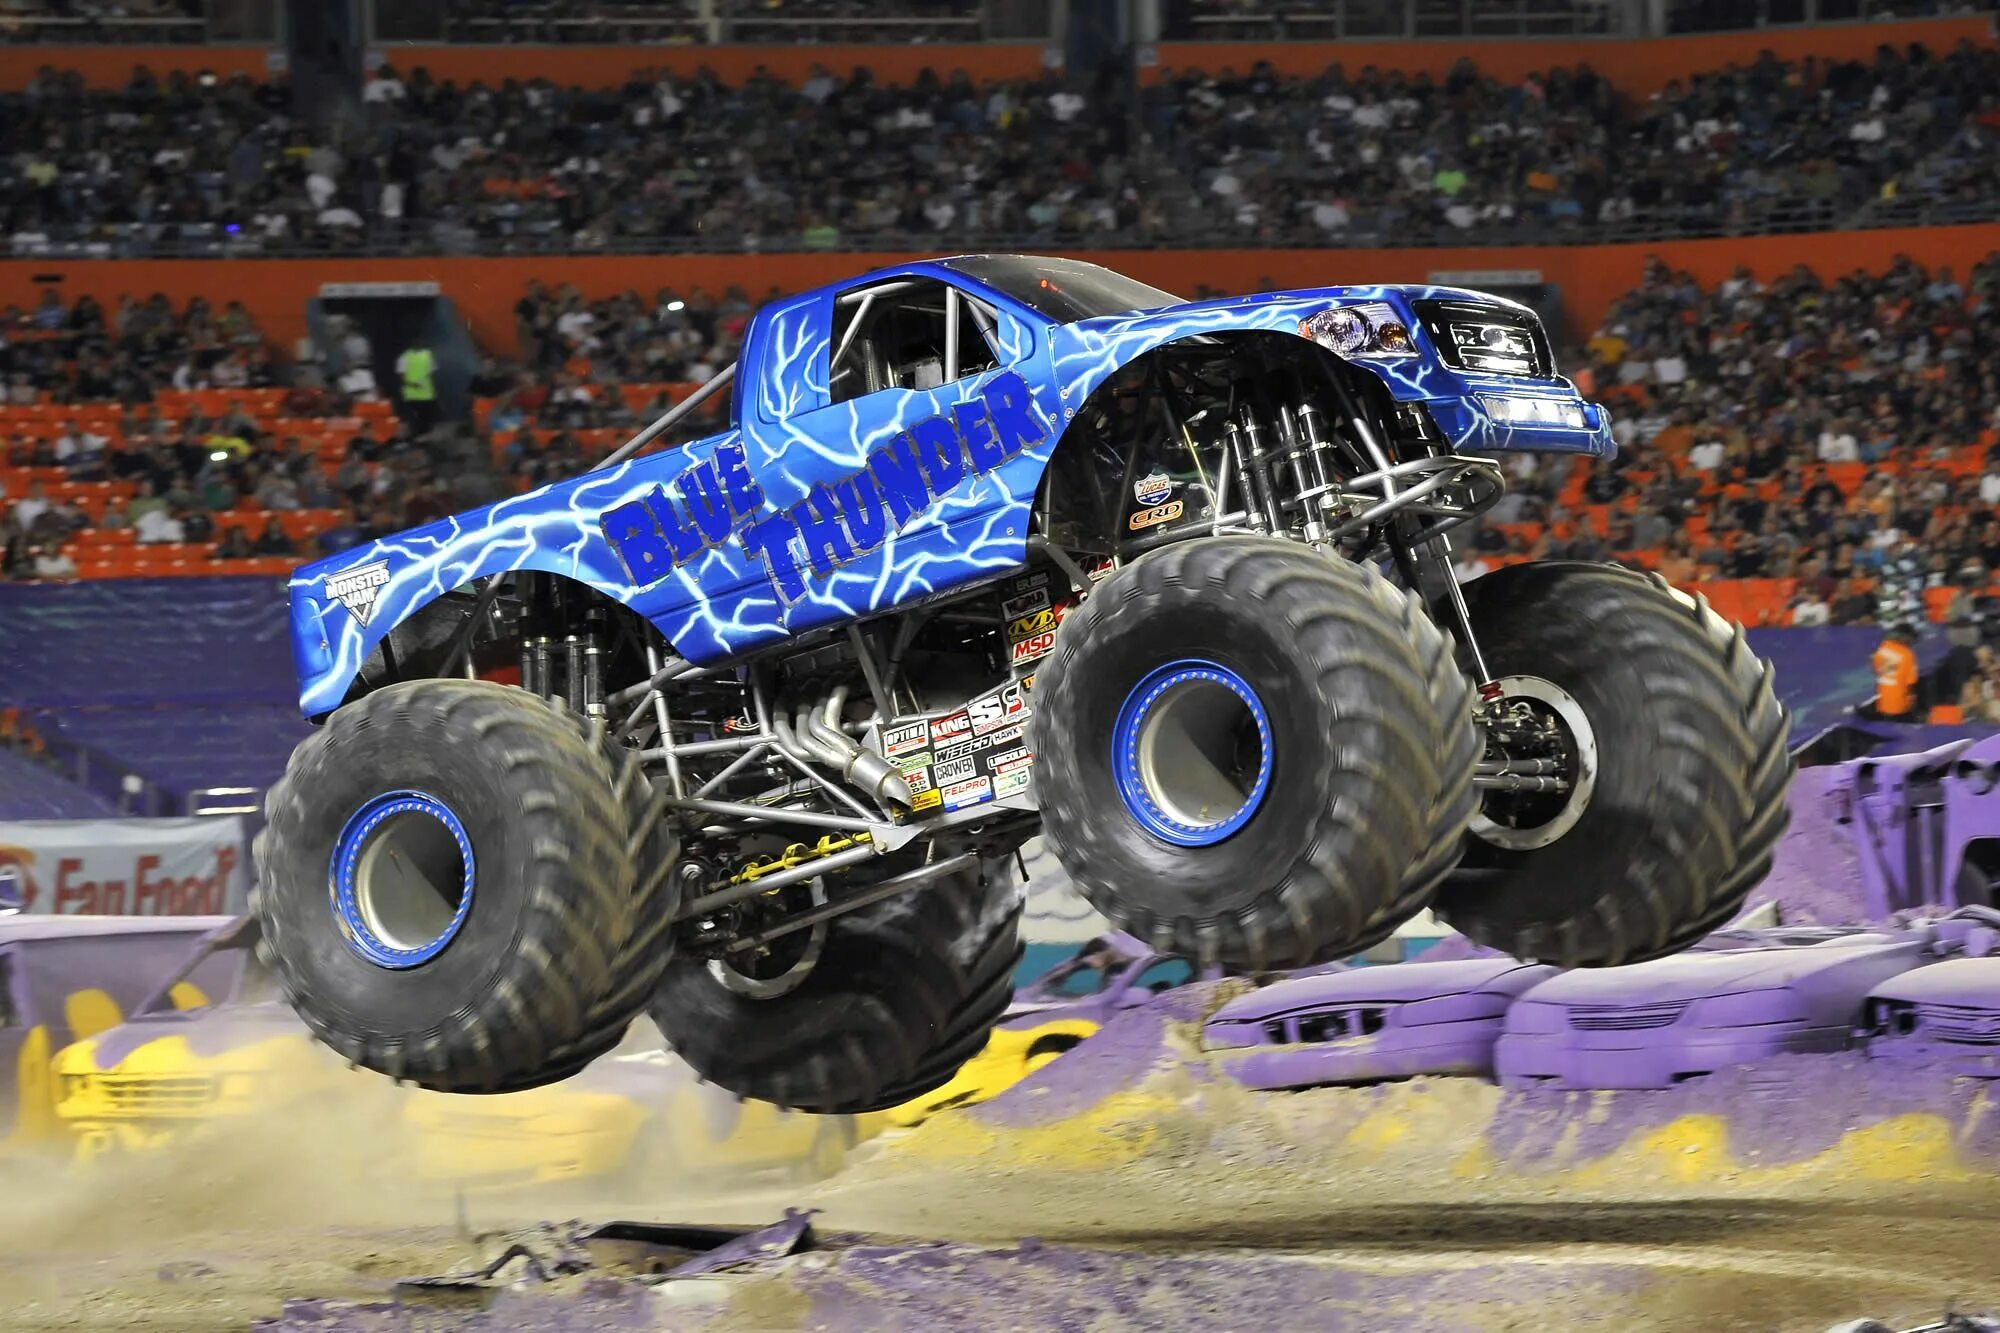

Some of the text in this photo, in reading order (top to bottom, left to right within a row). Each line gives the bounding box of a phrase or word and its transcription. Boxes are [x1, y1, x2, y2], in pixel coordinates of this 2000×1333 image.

[742, 368, 1046, 606] THUNDER
[1141, 482, 1167, 494] LUCAS
[601, 443, 764, 592] BLUE
[1133, 504, 1180, 524] CRD
[326, 568, 391, 599] MONSTER
[342, 587, 376, 608] JAM
[1014, 633, 1055, 659] MSD
[887, 724, 925, 746] OPTIMA
[930, 716, 970, 737] KING
[976, 720, 1004, 735] SIMPSON
[994, 728, 1019, 741] HAWK
[989, 749, 1027, 767] LINCOLN
[936, 759, 975, 780] CROWER
[943, 779, 987, 798] FEL-PRO
